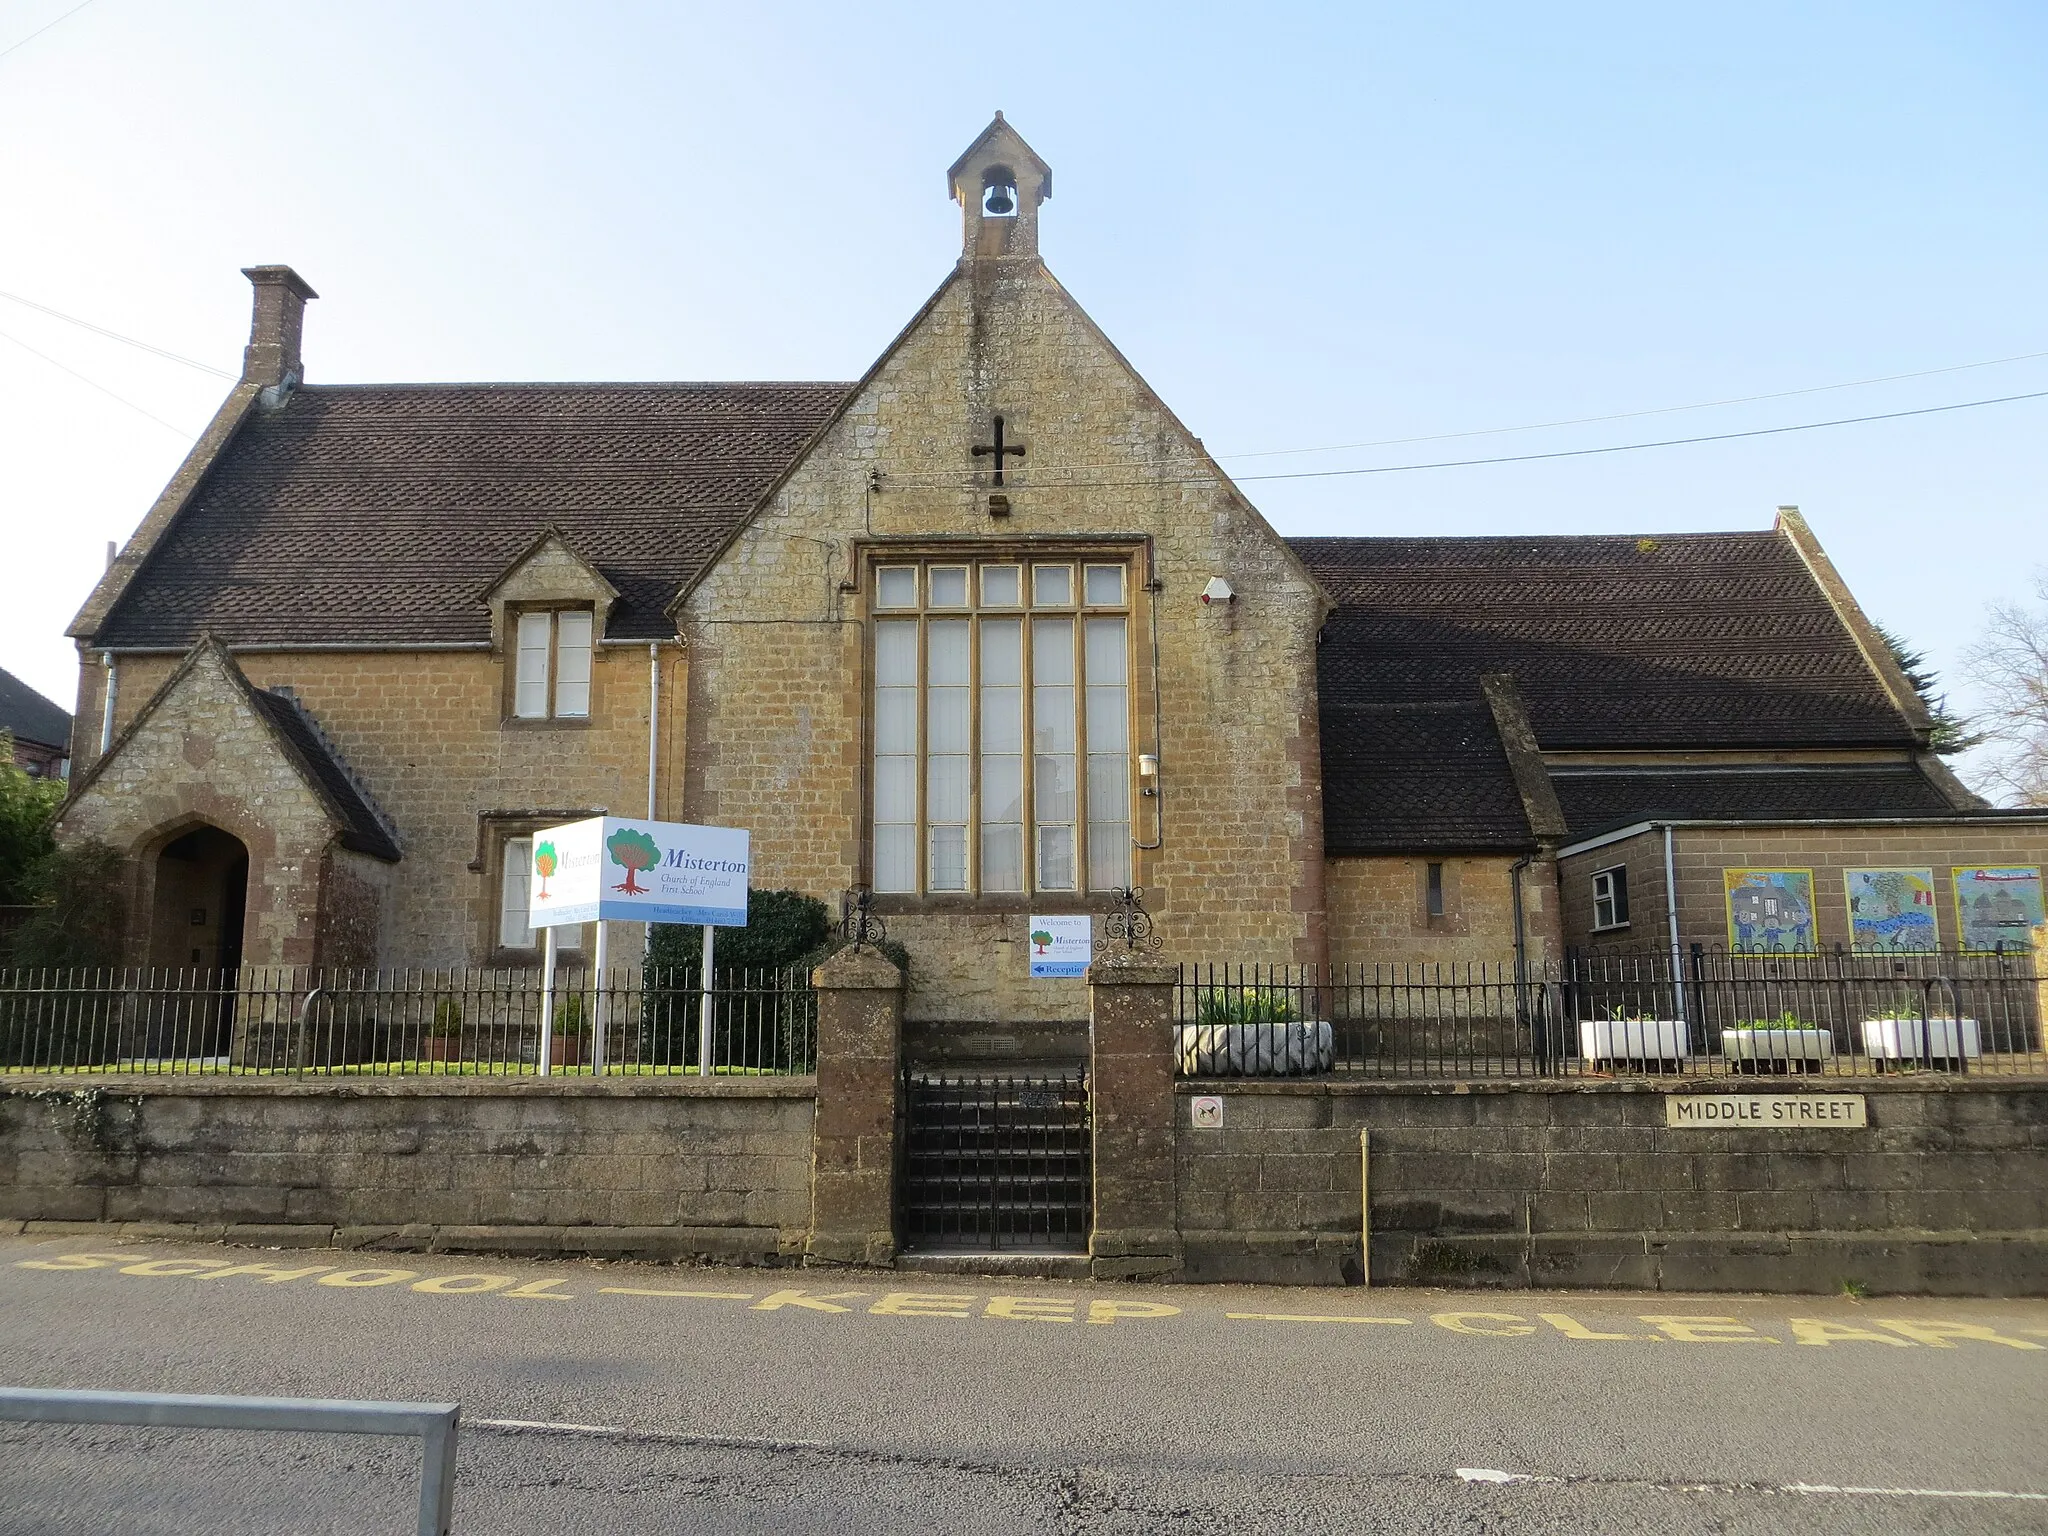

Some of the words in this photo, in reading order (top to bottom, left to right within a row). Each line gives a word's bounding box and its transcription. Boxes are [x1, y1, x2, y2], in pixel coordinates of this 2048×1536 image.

[662, 848, 746, 873] Misterton
[661, 873, 688, 884] Church
[690, 876, 698, 886] of
[700, 876, 731, 889] England
[661, 884, 678, 894] First
[681, 885, 705, 895] School
[1054, 936, 1090, 945] Misterton
[1677, 1102, 1762, 1120] MIDDLE
[1772, 1102, 1855, 1120] STREET
[18, 1253, 575, 1301] SCHOOL
[748, 1289, 1183, 1325] KEEP
[1429, 1311, 2046, 1350] CLEAR
